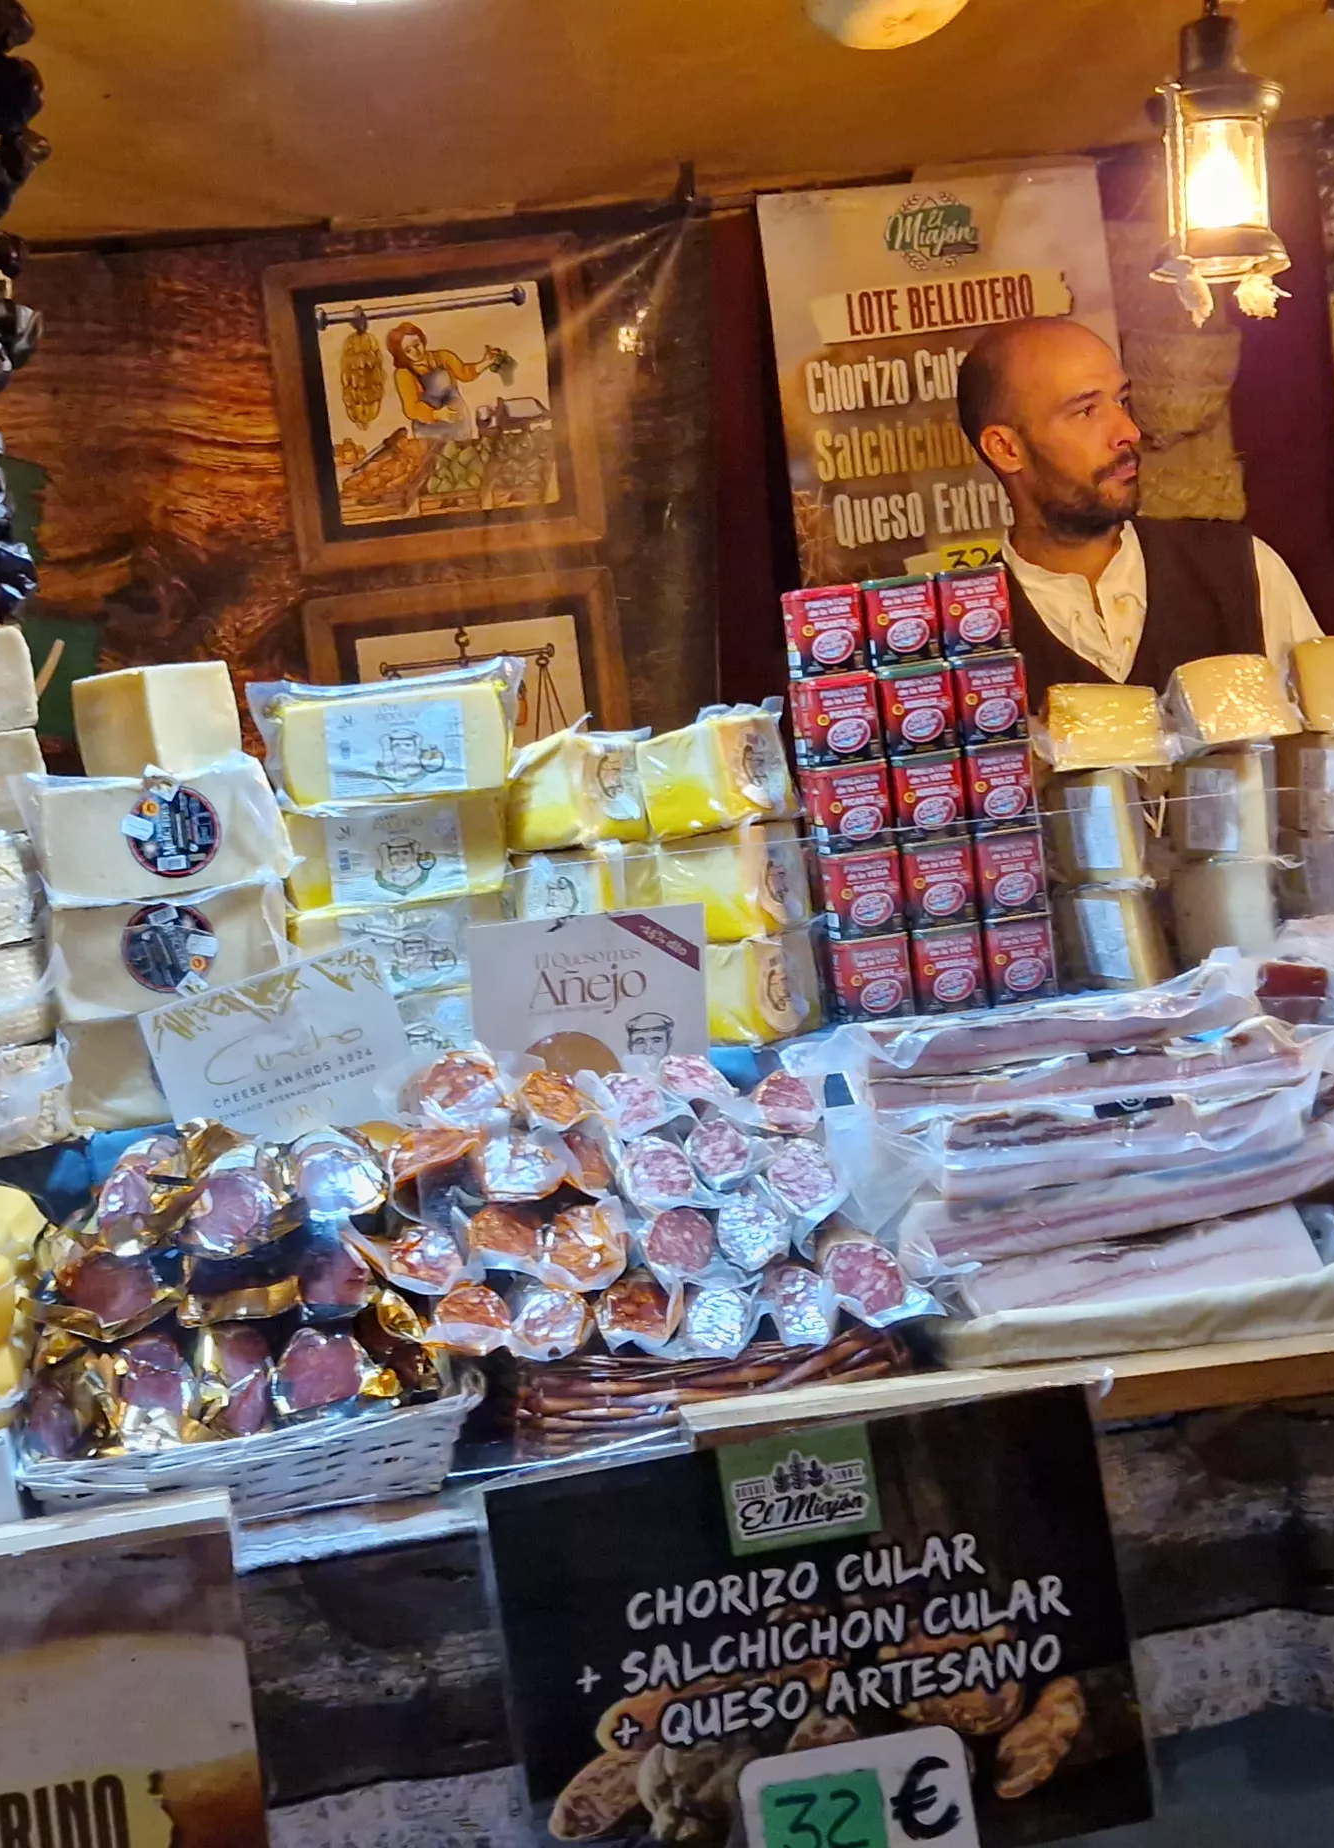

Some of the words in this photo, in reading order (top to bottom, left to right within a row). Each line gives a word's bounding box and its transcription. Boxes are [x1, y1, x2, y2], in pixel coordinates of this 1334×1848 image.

[886, 212, 976, 256] Miajón
[927, 209, 945, 227] El
[846, 289, 901, 336] LOTE
[907, 273, 1034, 329] BELLOTERO
[805, 356, 909, 415] Chorizo
[913, 347, 967, 402] Cul
[832, 490, 926, 550] Queso
[932, 479, 1015, 536] Extre
[529, 963, 647, 1014] Añejo
[213, 1083, 268, 1109] CHEESE
[274, 1061, 332, 1088] AWARDS
[338, 1048, 373, 1067] 2024
[740, 1500, 774, 1530] El
[775, 1492, 863, 1522] Miajón
[626, 1562, 818, 1632] CHORIZO
[836, 1533, 986, 1593] CULAR
[576, 1665, 601, 1695] +
[620, 1604, 907, 1695] SALCHICHON
[922, 1574, 1072, 1636] CULAR
[614, 1717, 643, 1747] +
[660, 1679, 806, 1747] QUESO
[825, 1633, 1062, 1715] ARTESANO
[774, 1789, 870, 1848] 32
[891, 1755, 961, 1838] €
